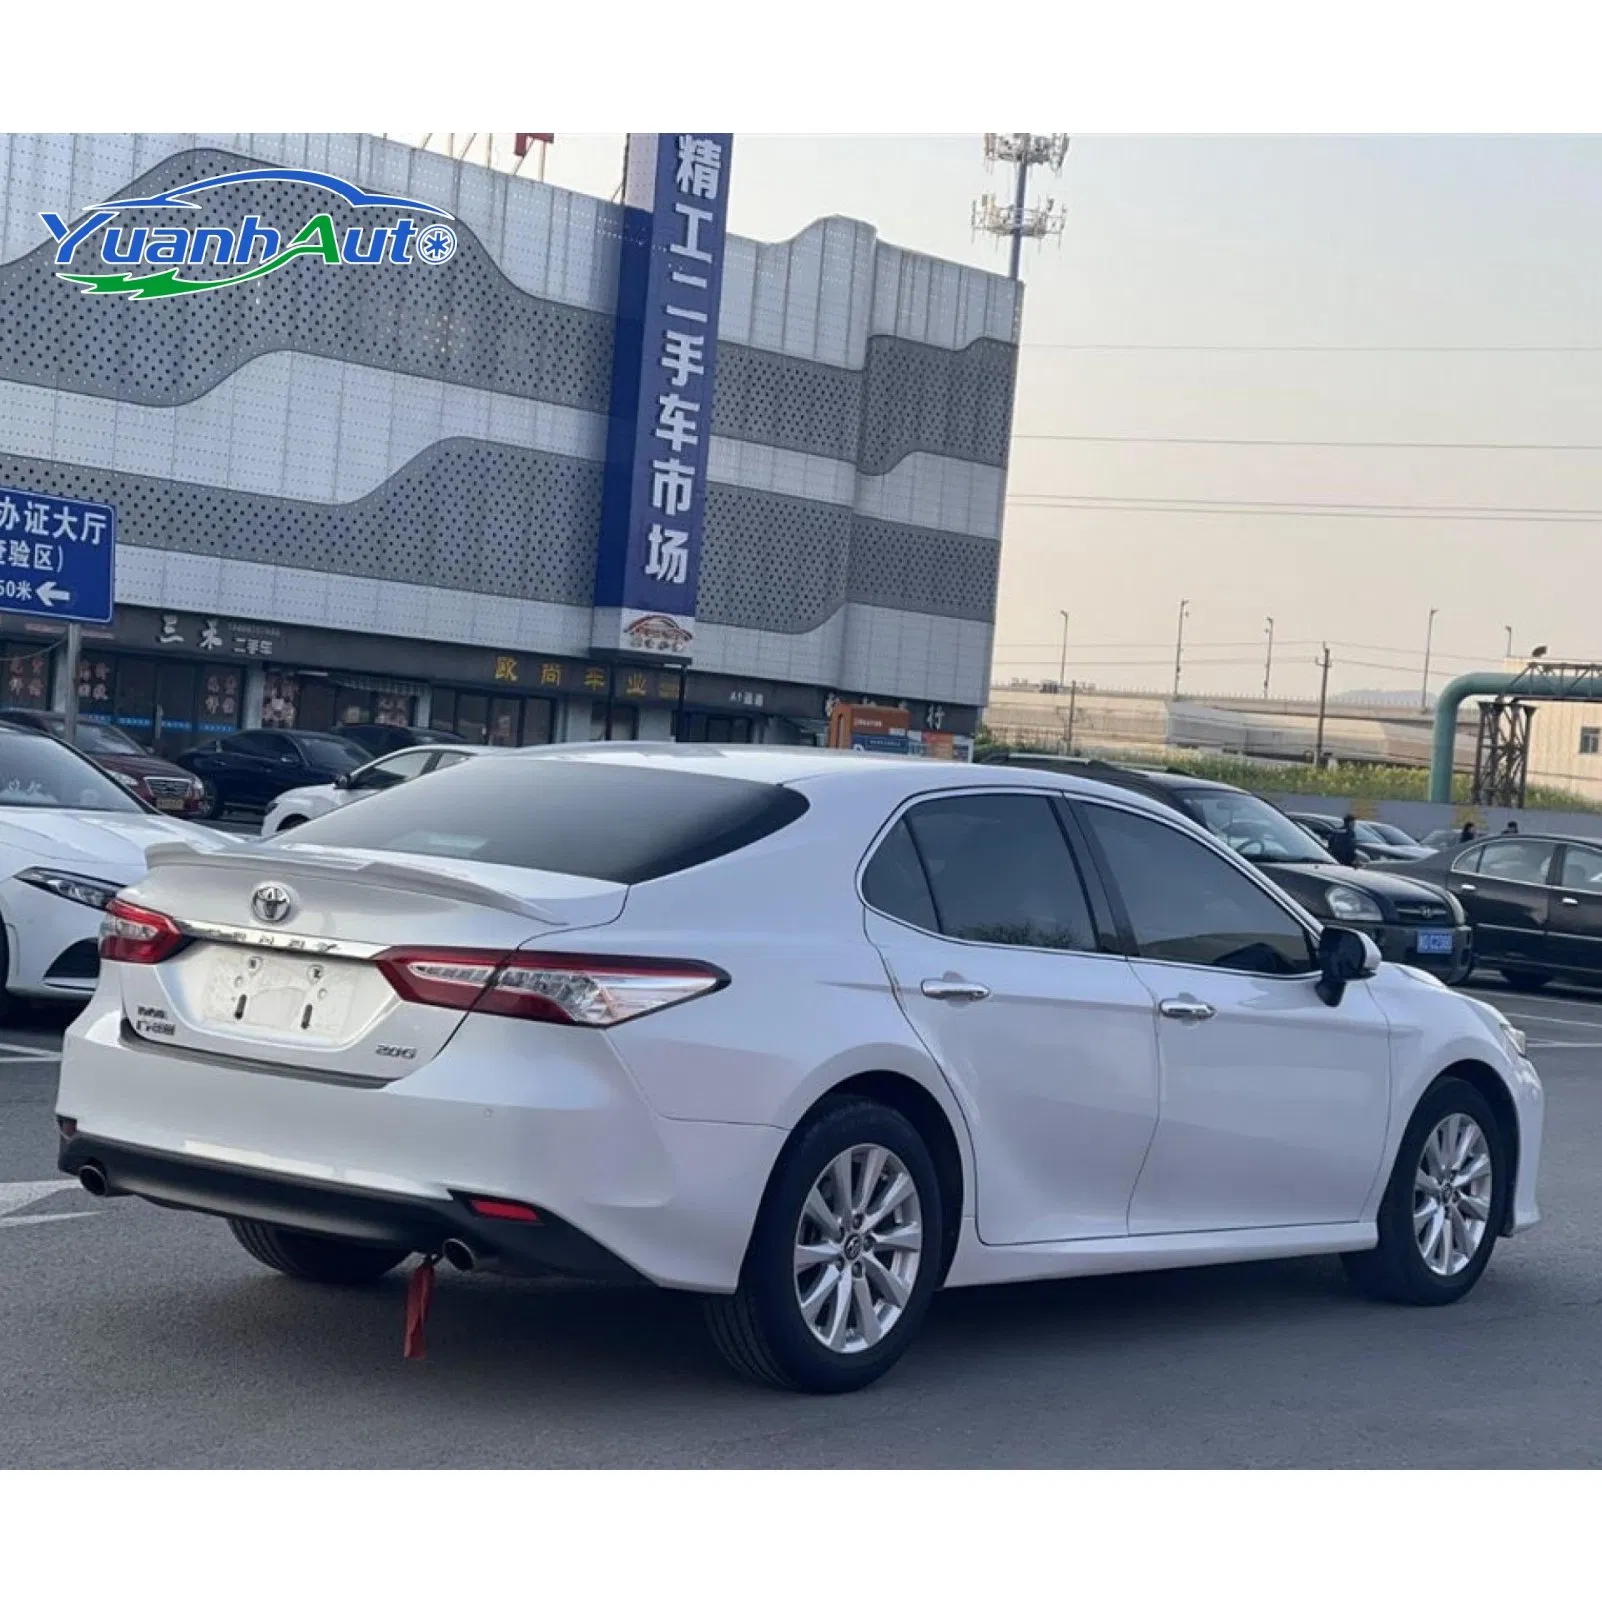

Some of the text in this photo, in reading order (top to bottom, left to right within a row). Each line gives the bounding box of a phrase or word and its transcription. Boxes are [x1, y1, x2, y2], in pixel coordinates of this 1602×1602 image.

[644, 134, 722, 586] 精工二手车市场
[0, 496, 107, 545] 办证大厅
